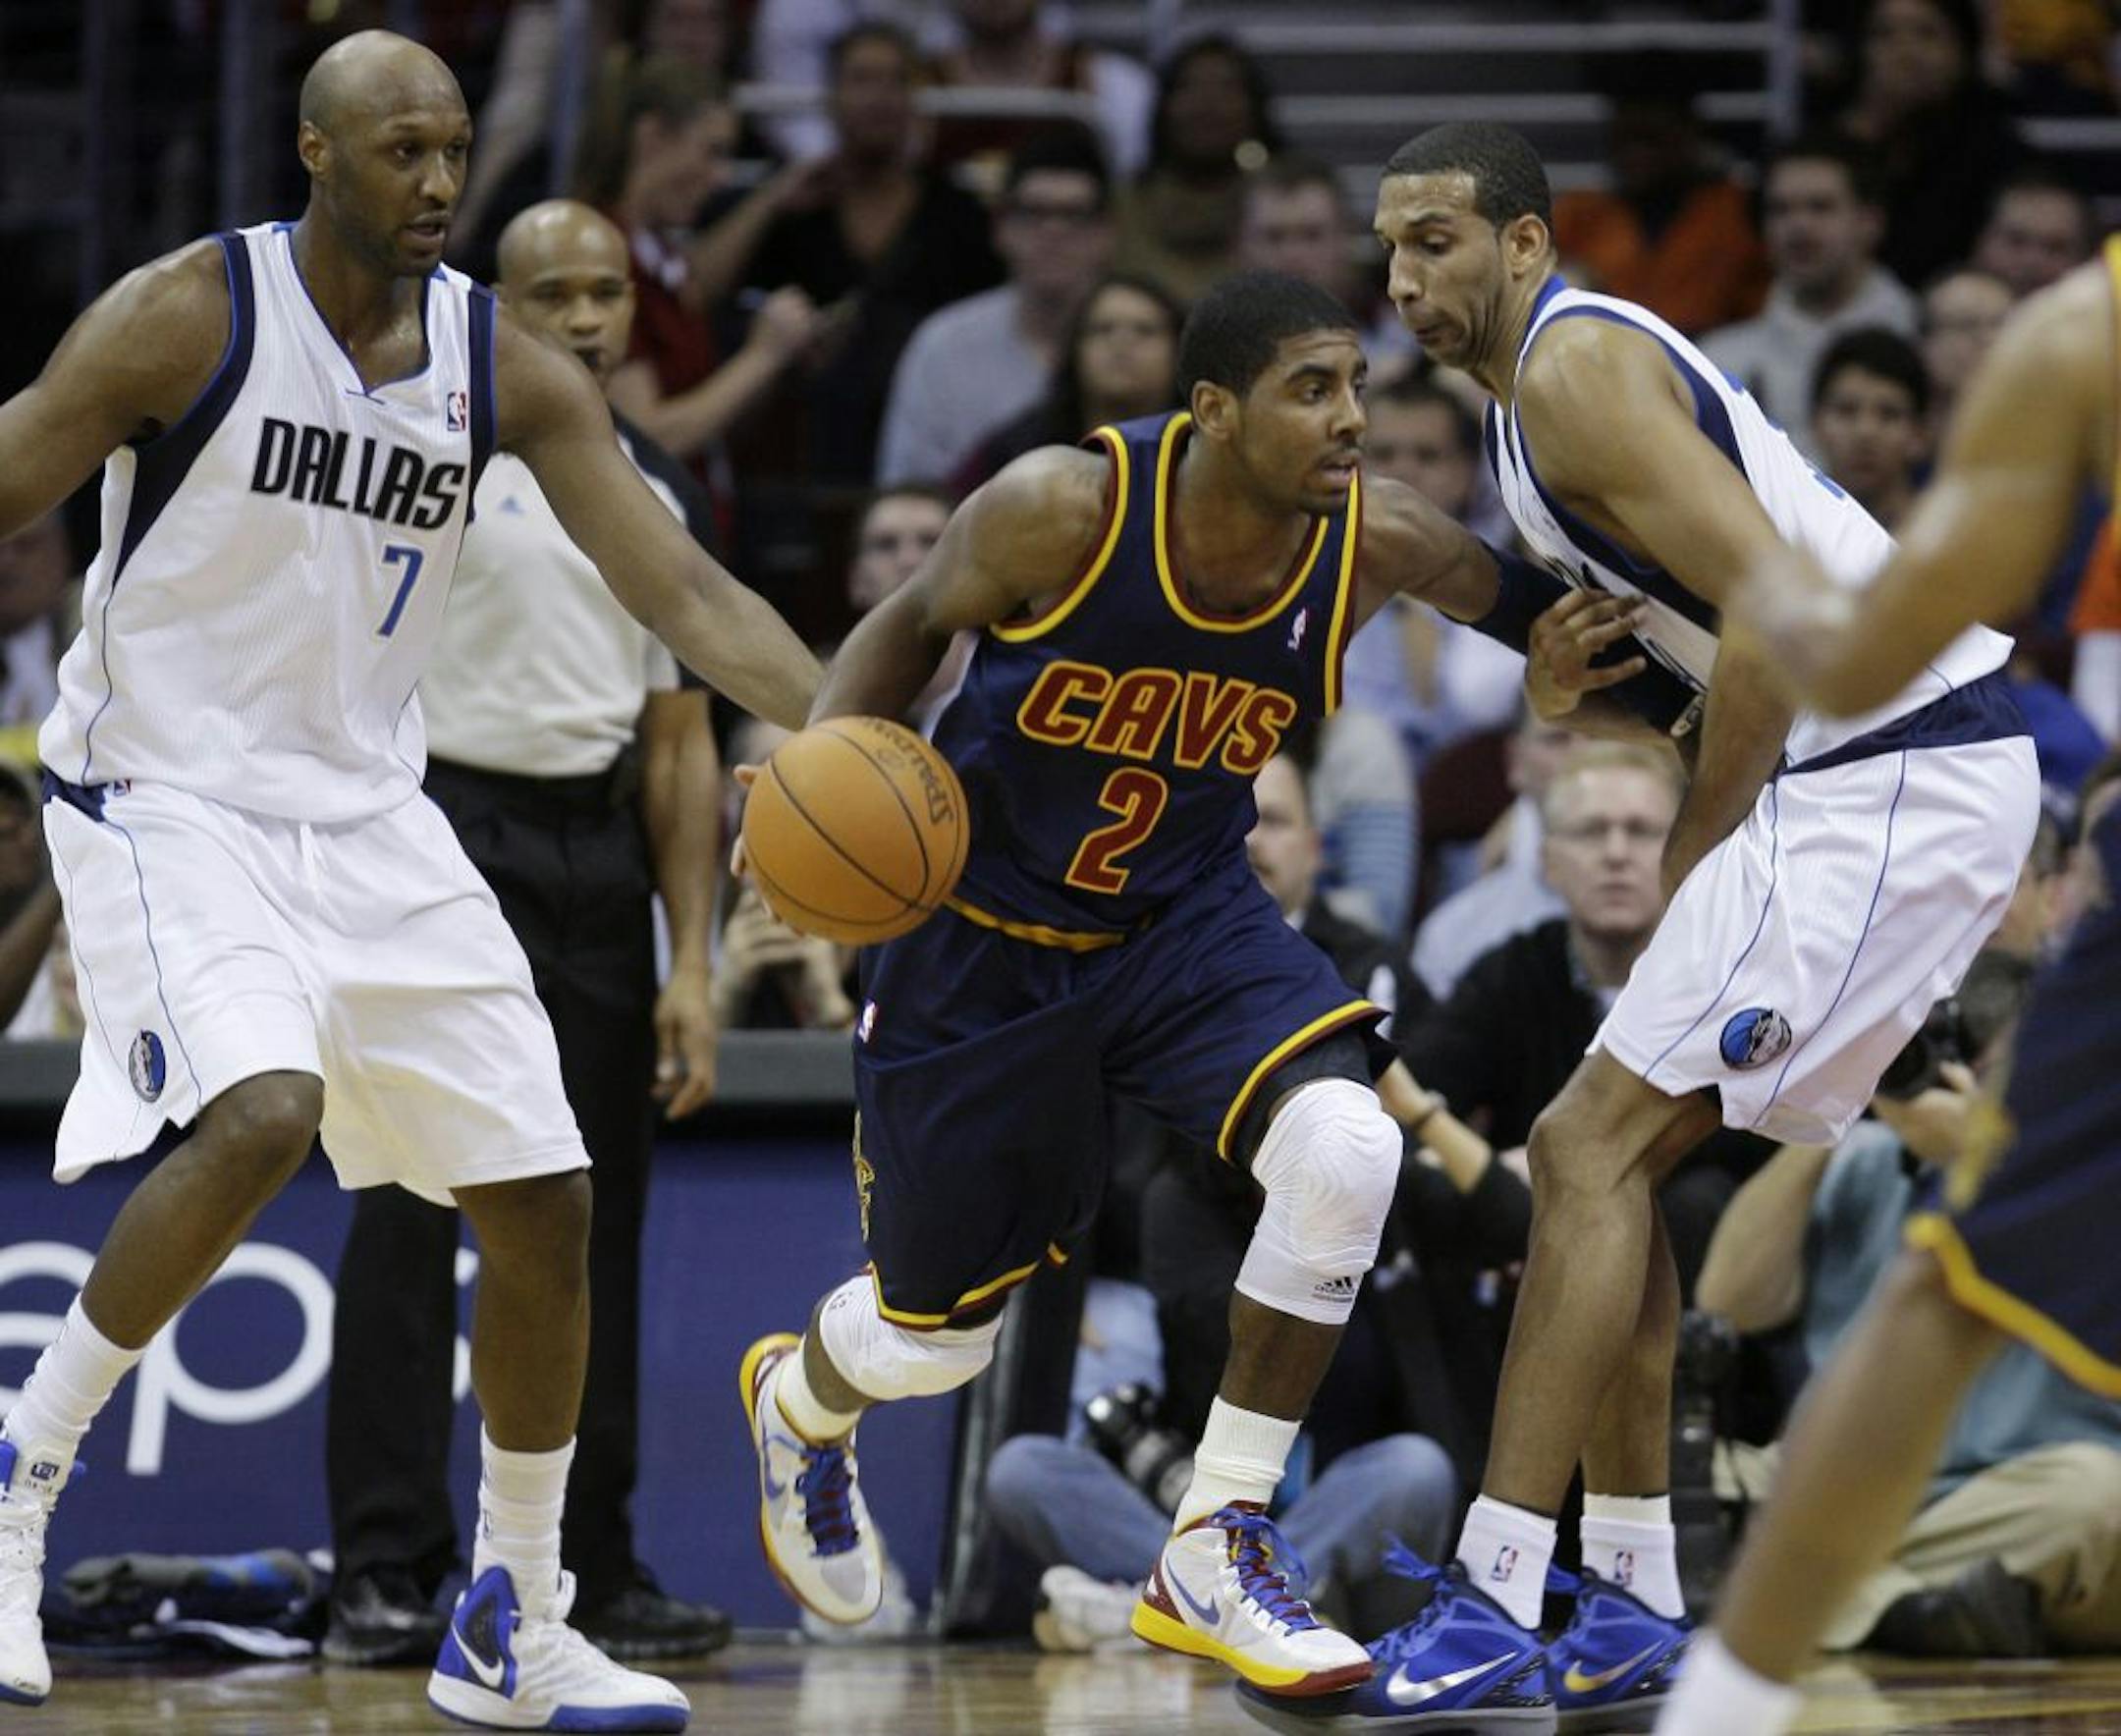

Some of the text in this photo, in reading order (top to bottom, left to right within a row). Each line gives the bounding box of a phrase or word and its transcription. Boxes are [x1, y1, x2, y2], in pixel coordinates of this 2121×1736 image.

[250, 417, 466, 530] DALLAS
[377, 544, 424, 637] 7
[1016, 660, 1297, 775] CAVS
[1064, 766, 1169, 895] 2
